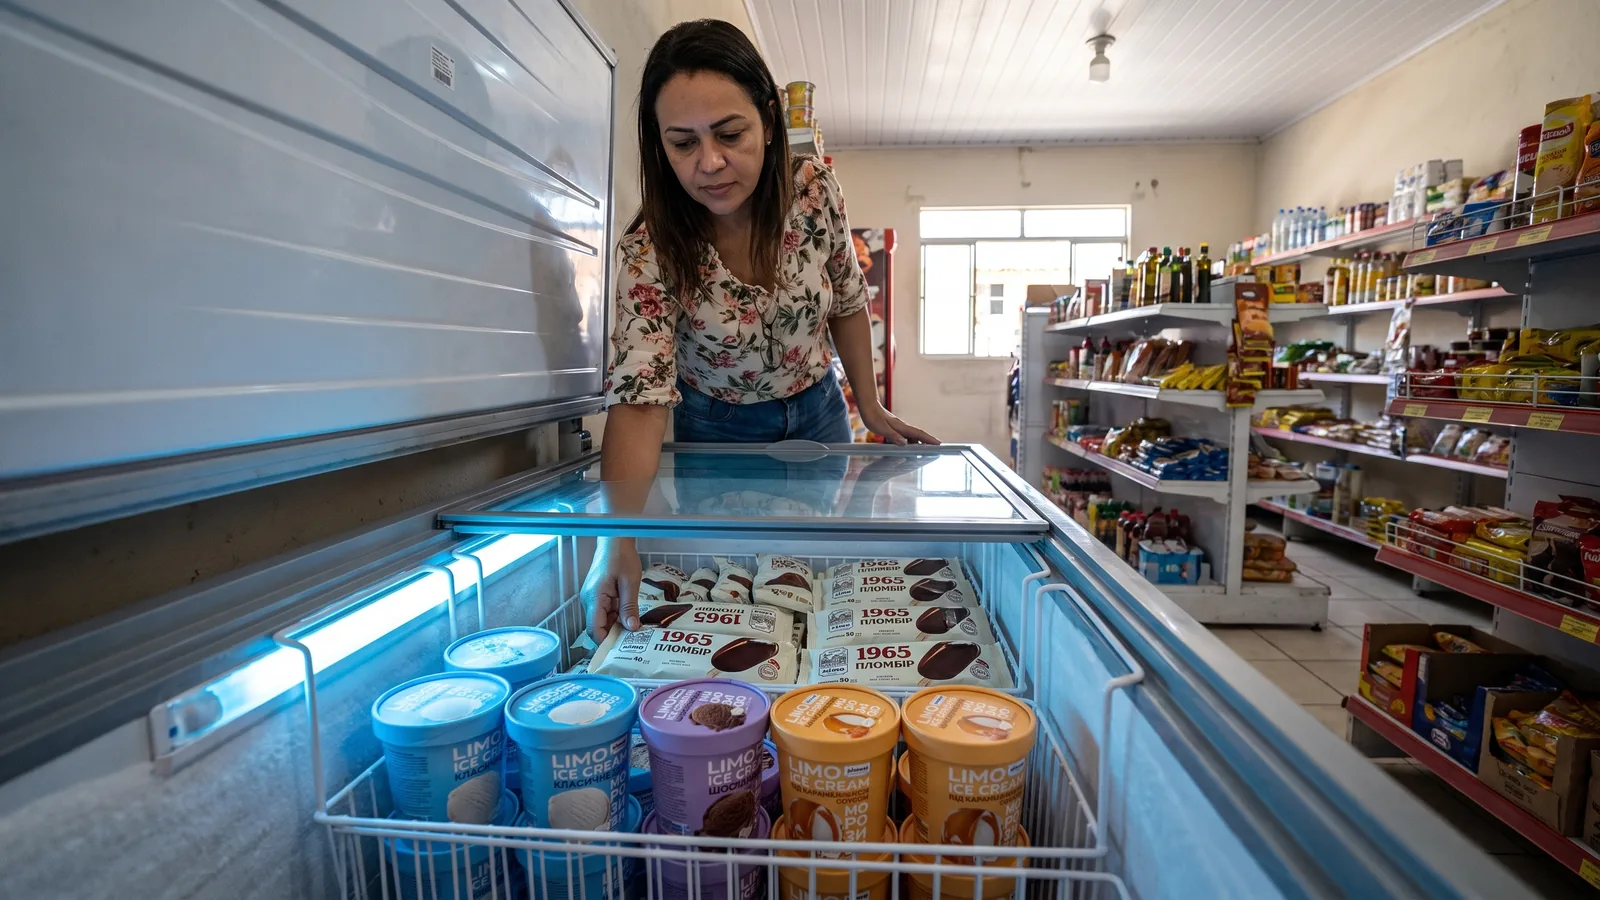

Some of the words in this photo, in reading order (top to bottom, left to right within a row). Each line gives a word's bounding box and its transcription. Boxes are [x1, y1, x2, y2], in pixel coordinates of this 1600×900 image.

[861, 576, 905, 586] 1965
[693, 611, 742, 625] 1965
[861, 608, 910, 618] 1965
[860, 617, 913, 625] ПЛОМБІР
[660, 630, 714, 647] 1965
[653, 643, 712, 656] ПЛОМБІР
[857, 645, 912, 660] 1965
[855, 660, 915, 670] ПЛОМБІР
[453, 730, 501, 761] LIMO
[454, 756, 479, 773] ICE
[552, 748, 608, 768] LIMO
[708, 749, 755, 774] LIMO
[553, 768, 578, 780] ICE
[789, 756, 841, 780] LIMO
[708, 772, 733, 786] ICE
[790, 771, 810, 788] ICE
[814, 776, 870, 791] CREAM
[949, 767, 1006, 784] LIMO
[949, 782, 973, 796] ICE
[845, 802, 868, 816] МО
[845, 814, 868, 829] РО
